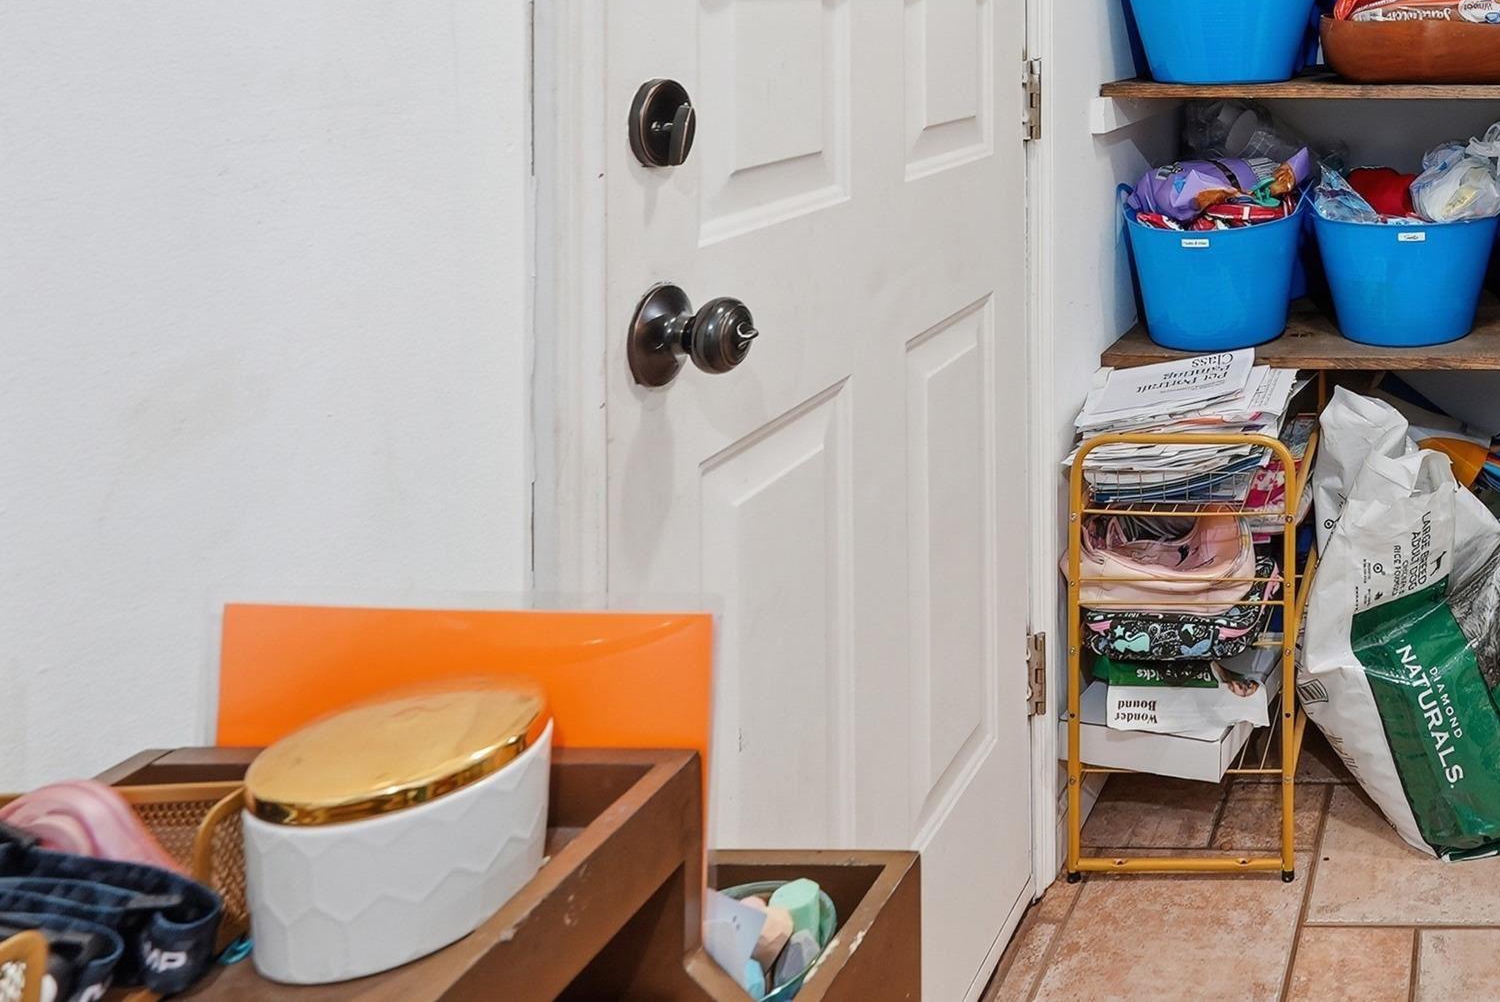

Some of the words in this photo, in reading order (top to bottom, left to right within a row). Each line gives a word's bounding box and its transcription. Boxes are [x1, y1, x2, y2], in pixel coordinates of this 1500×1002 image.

[1191, 352, 1234, 369] Class
[1117, 700, 1157, 711] Bound
[1429, 666, 1463, 739] DIAMOND
[1114, 712, 1159, 724] Wonder
